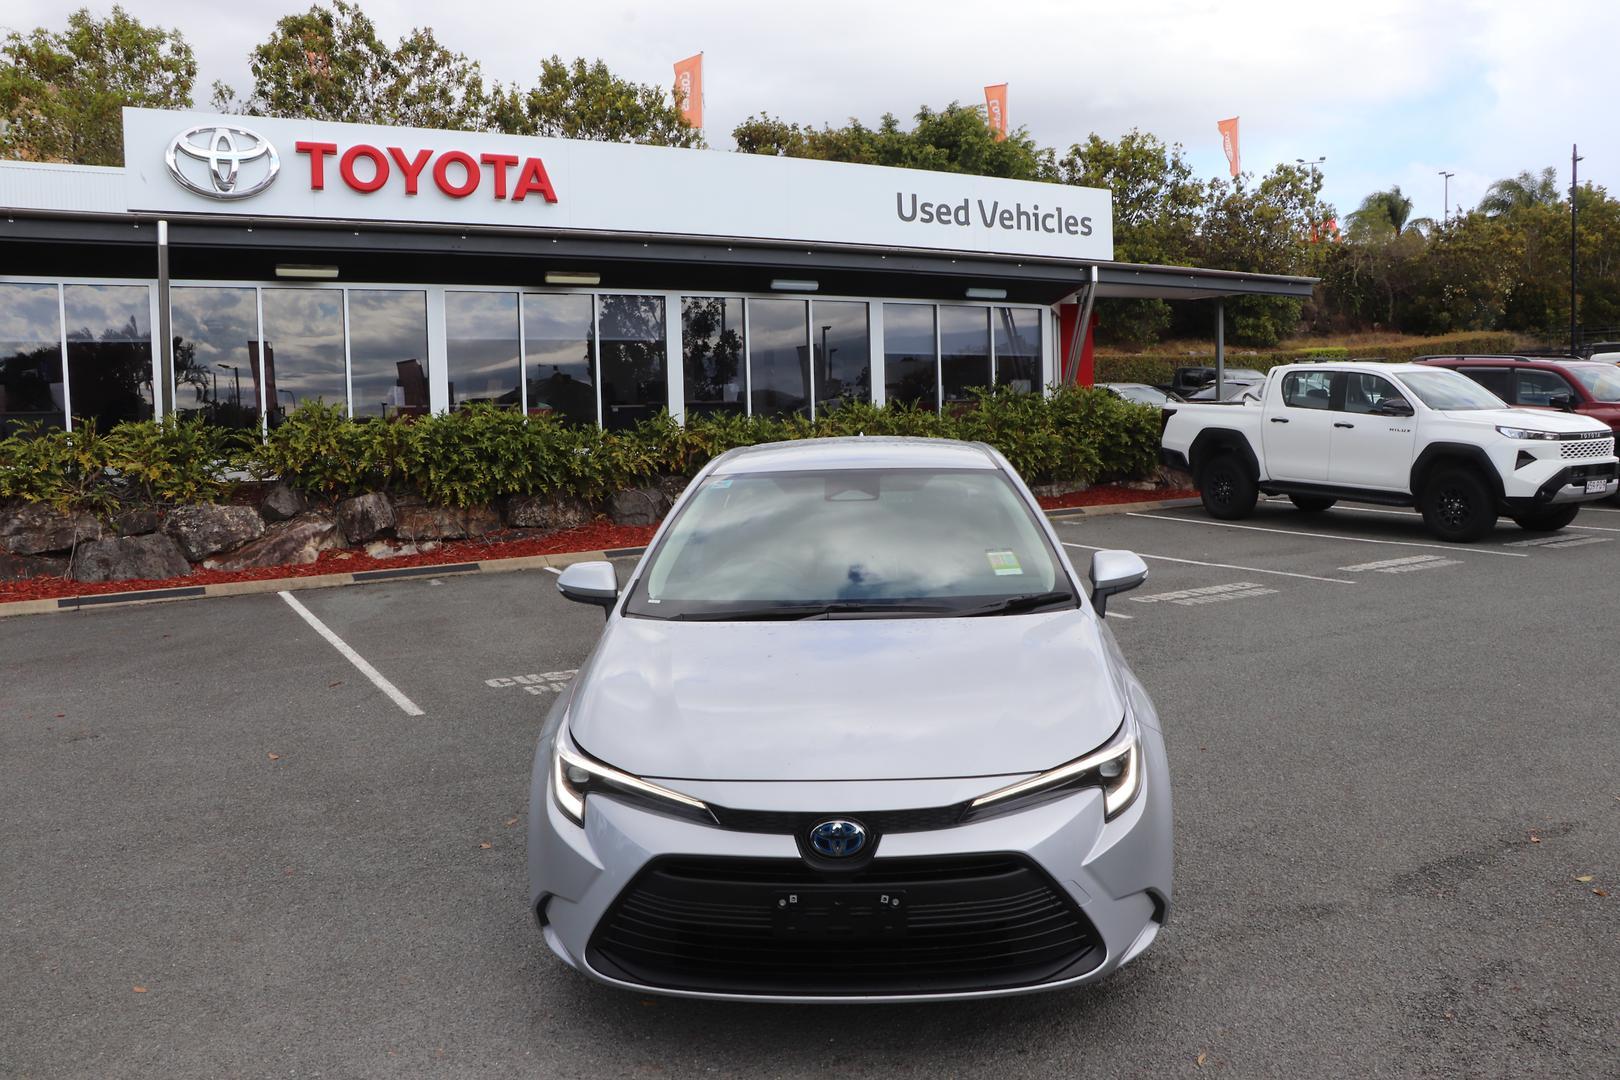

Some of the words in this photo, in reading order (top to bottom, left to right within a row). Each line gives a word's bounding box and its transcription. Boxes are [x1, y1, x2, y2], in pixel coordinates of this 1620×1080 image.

[295, 141, 558, 204] TOYOTA
[896, 192, 971, 227] Used
[977, 199, 1093, 237] Vehicles
[1580, 431, 1601, 439] TOYOTA
